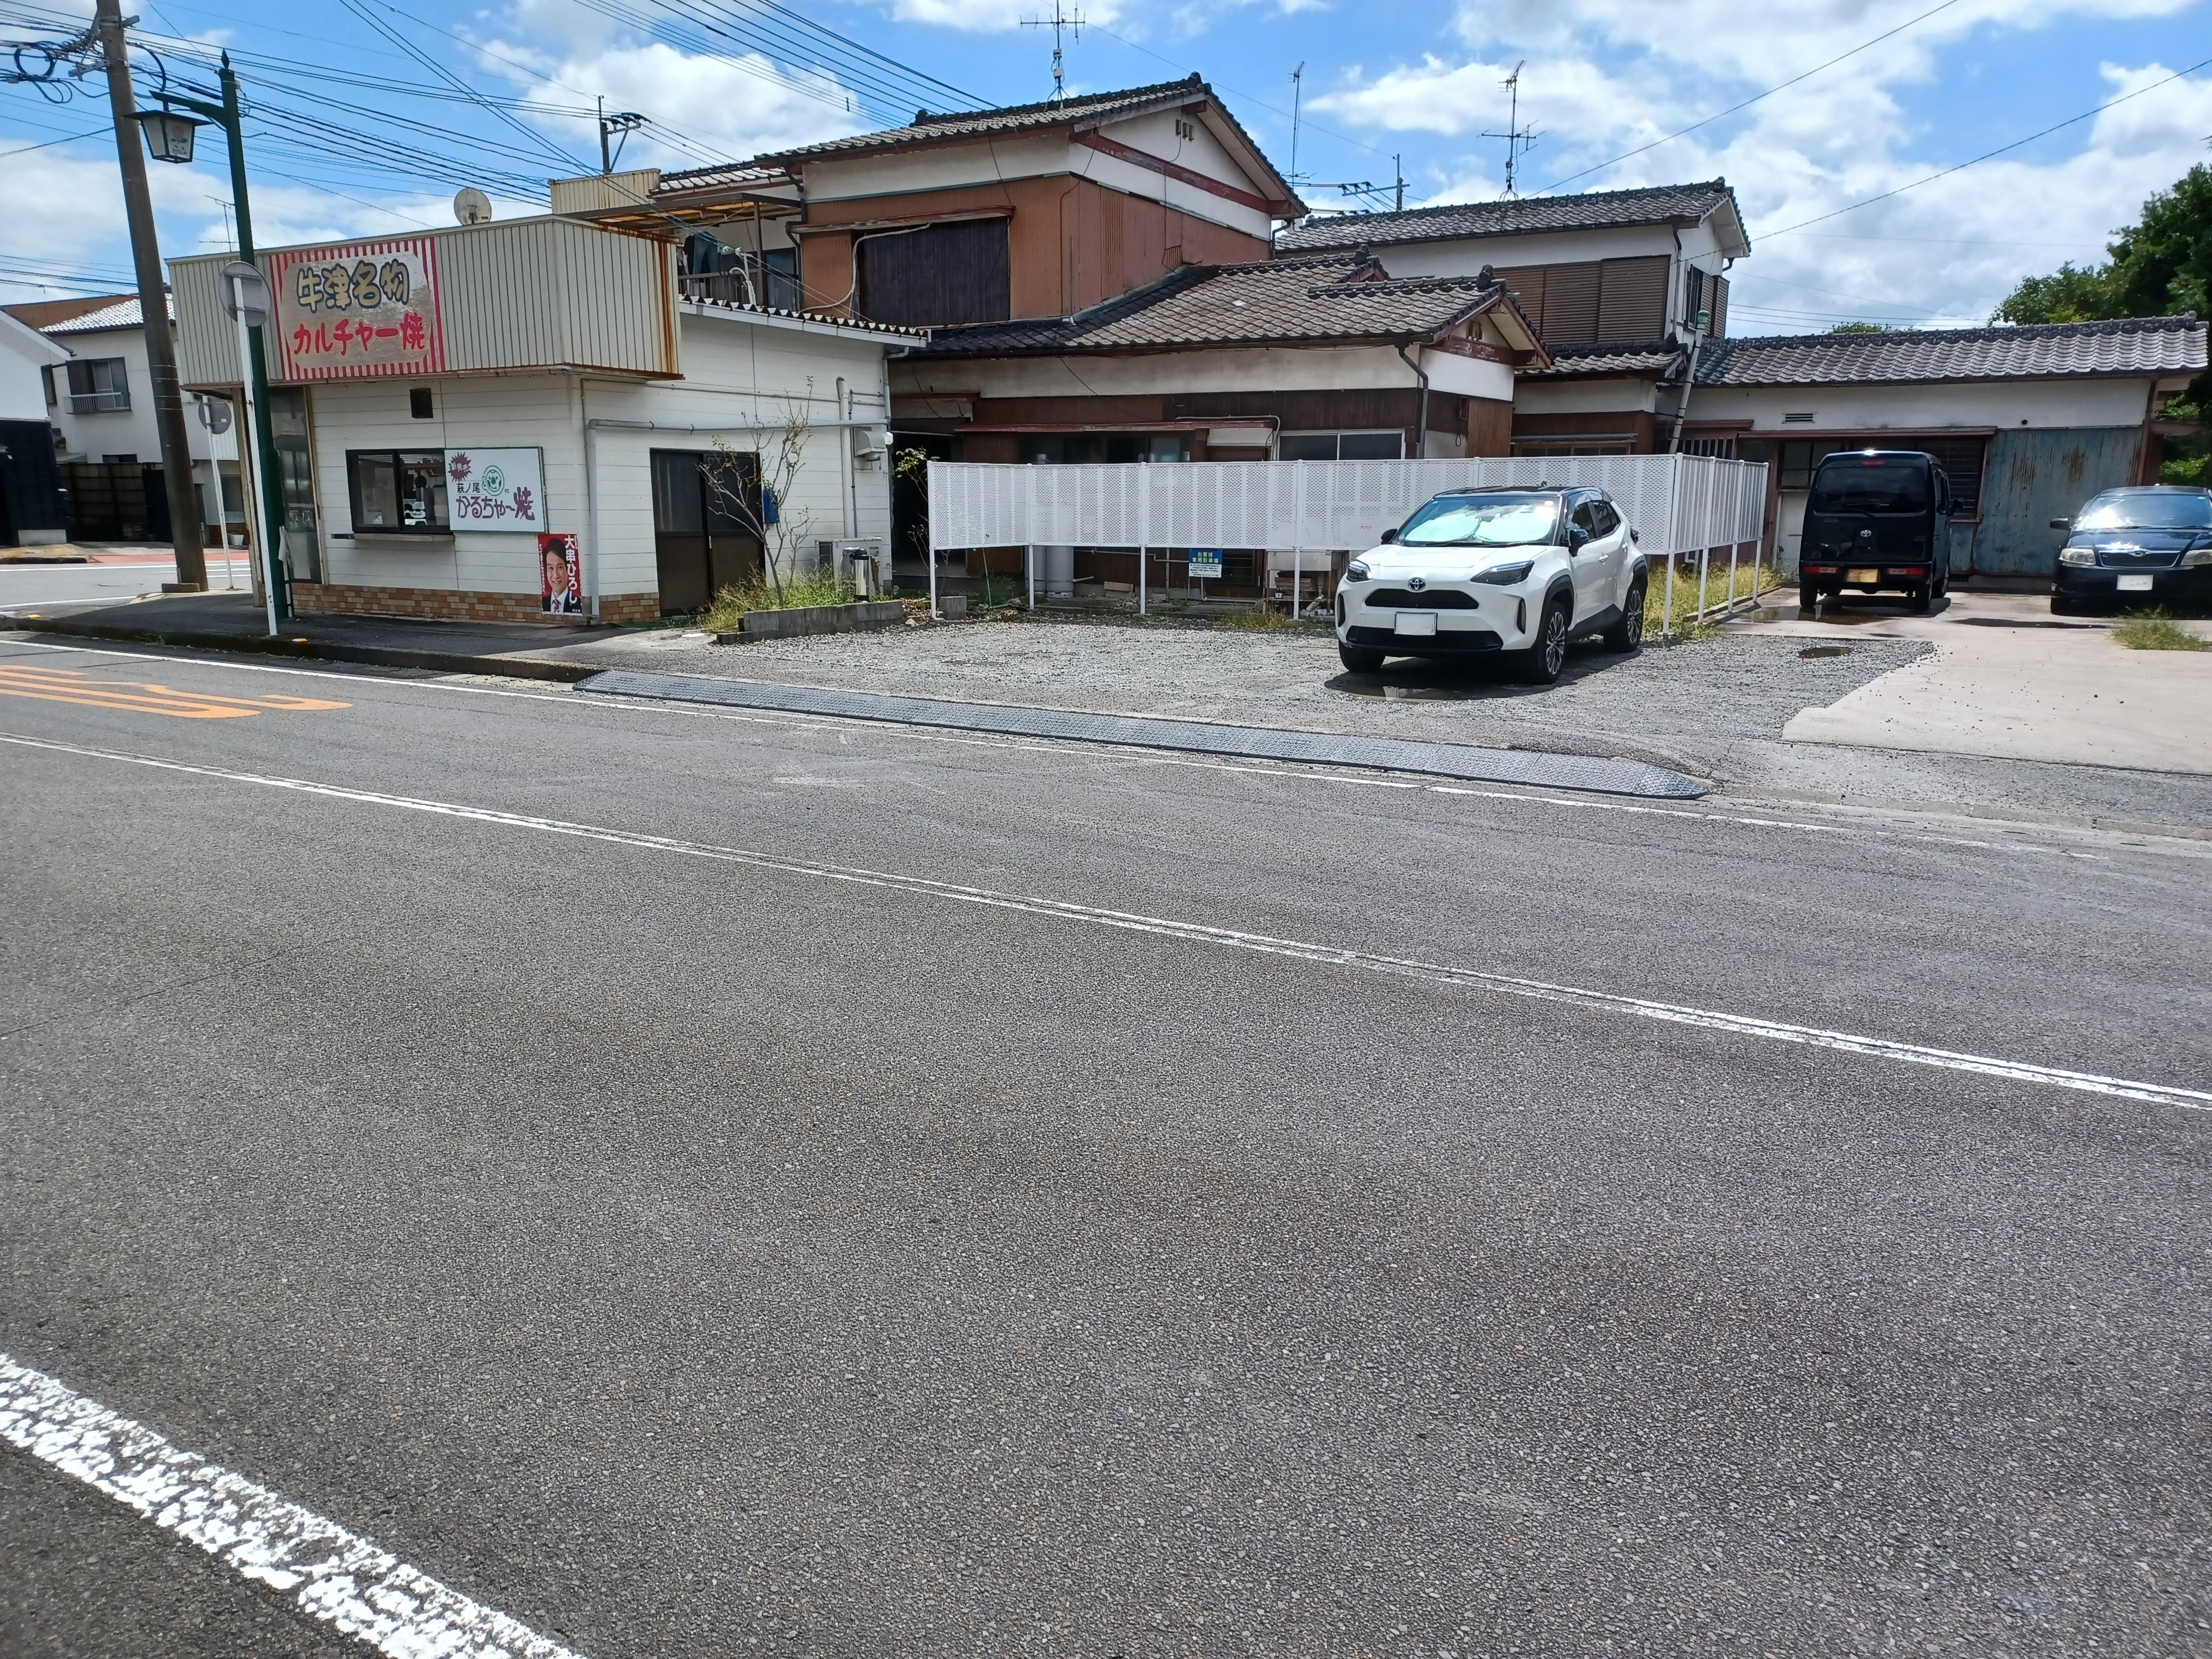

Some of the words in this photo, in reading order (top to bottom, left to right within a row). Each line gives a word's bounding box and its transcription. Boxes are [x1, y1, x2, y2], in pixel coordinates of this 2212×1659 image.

[296, 258, 410, 314] 牛津名物
[294, 312, 425, 356] カルチャー焼
[564, 535, 578, 604] 大串ひろし
